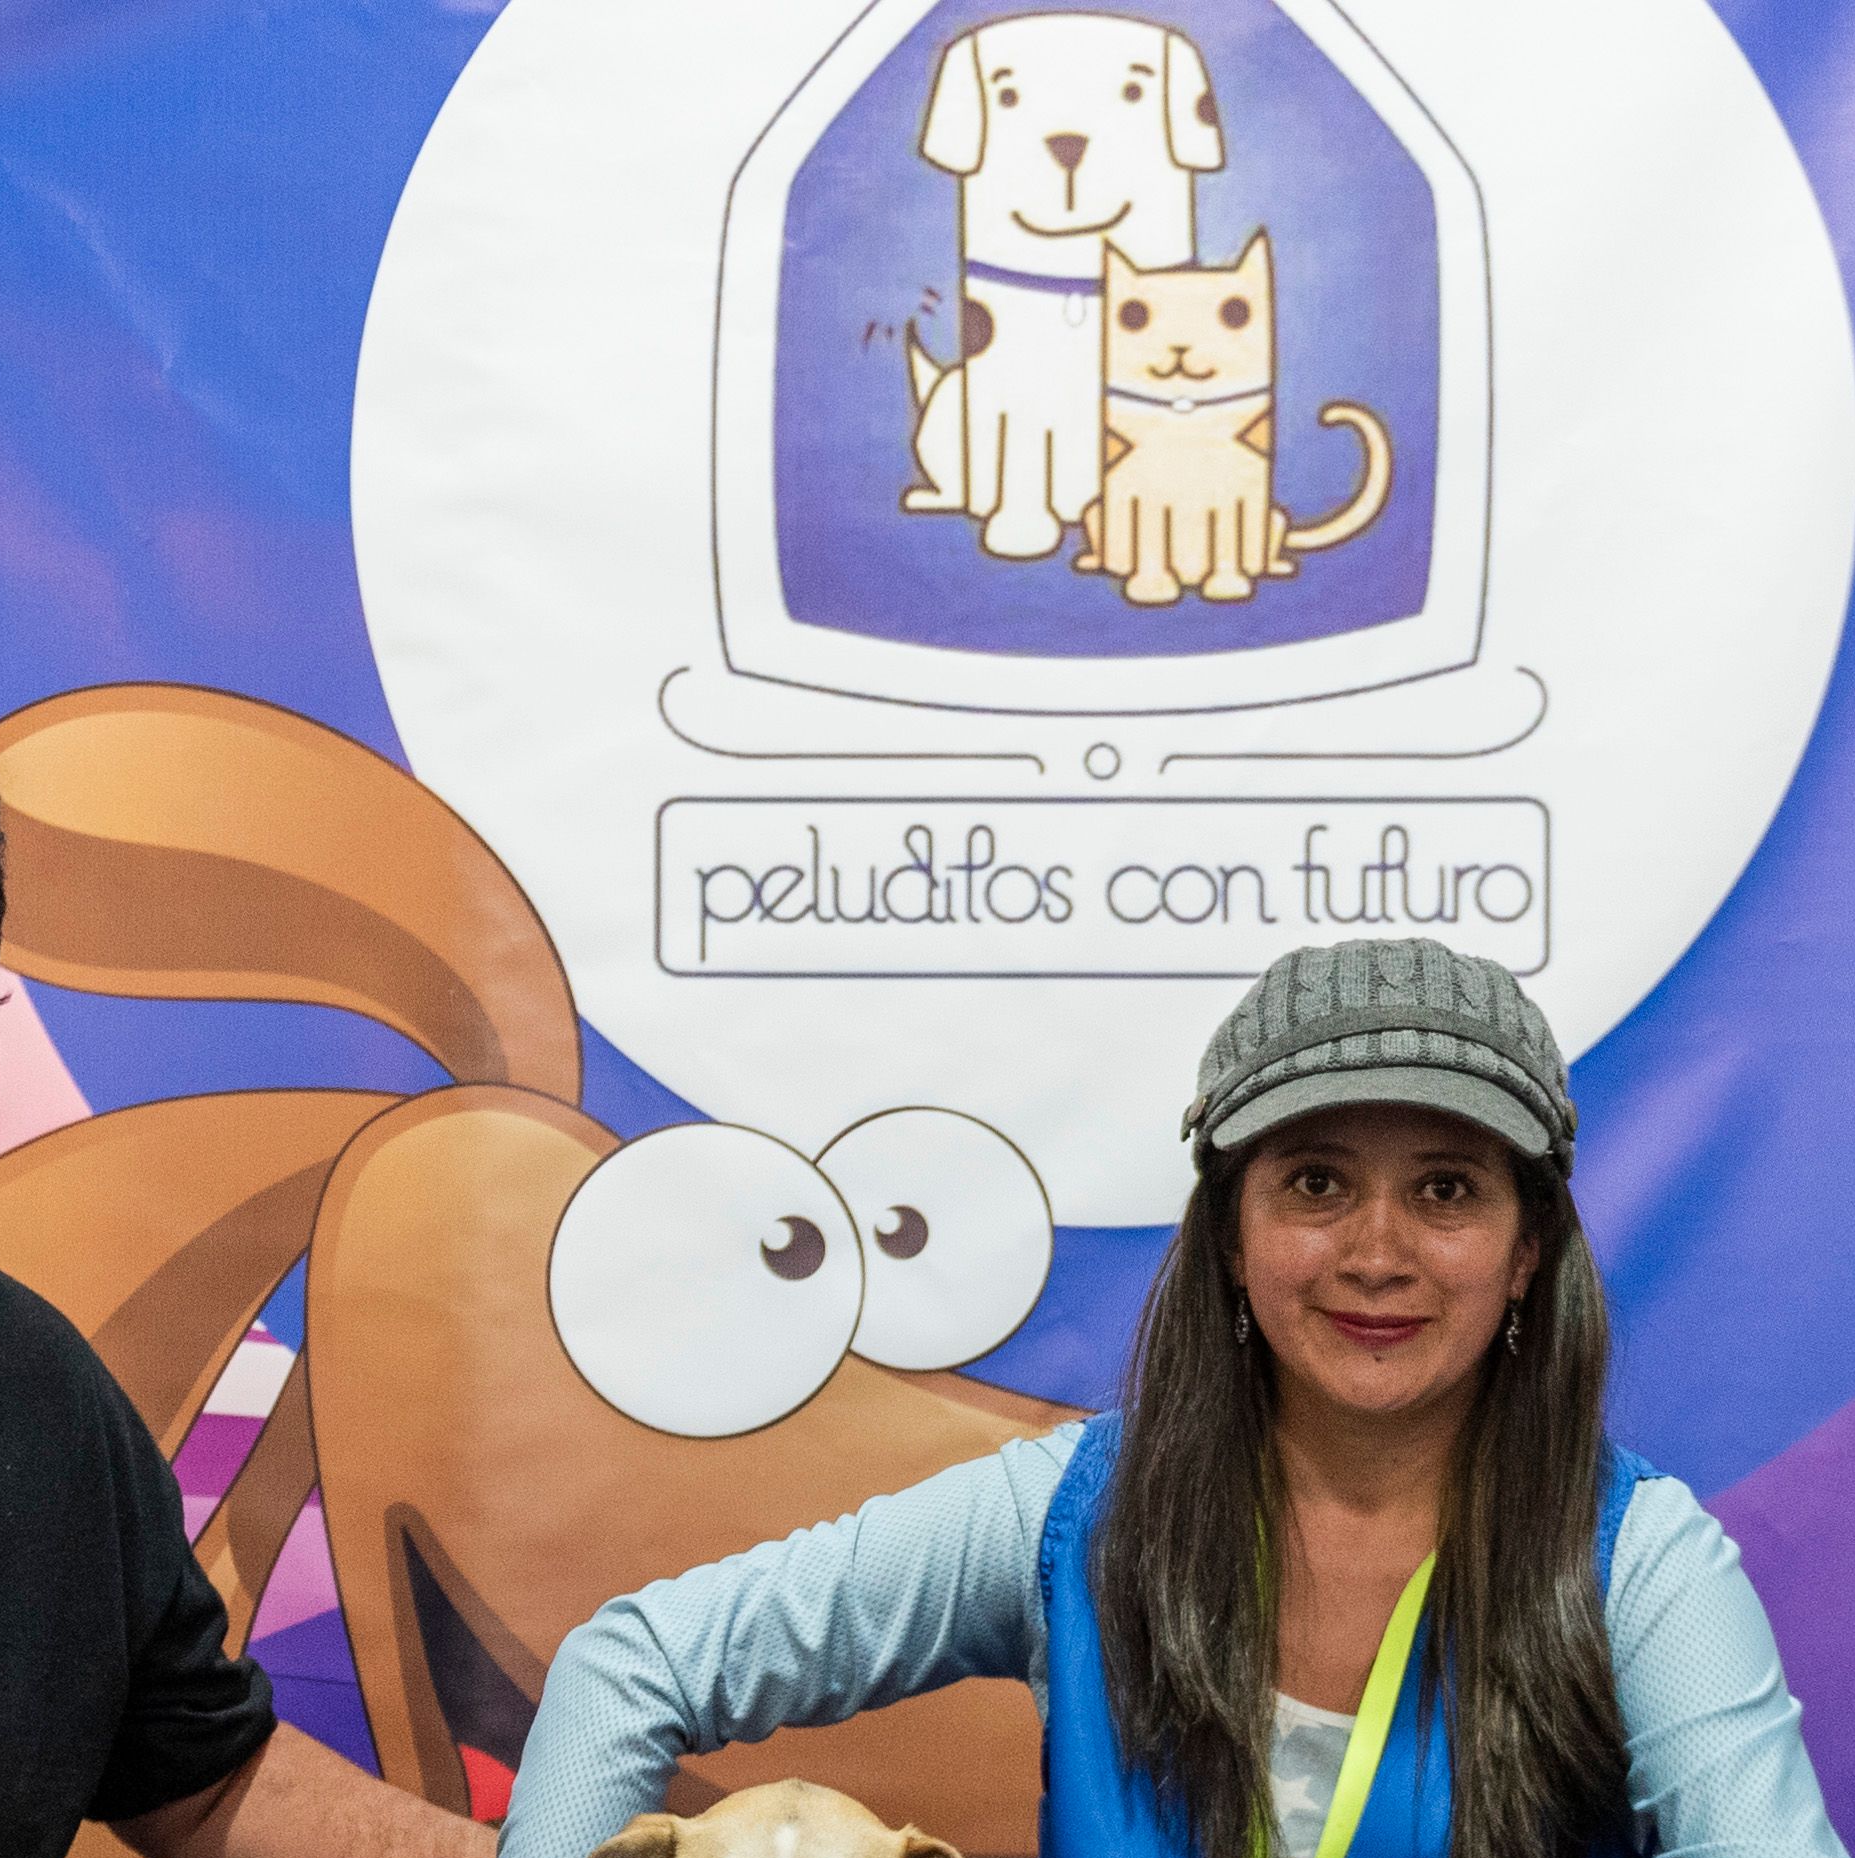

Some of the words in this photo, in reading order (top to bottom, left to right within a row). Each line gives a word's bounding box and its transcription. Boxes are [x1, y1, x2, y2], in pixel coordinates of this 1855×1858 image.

[695, 825, 1074, 963] peluditos
[1106, 864, 1277, 925] con
[1290, 825, 1535, 925] futuro
